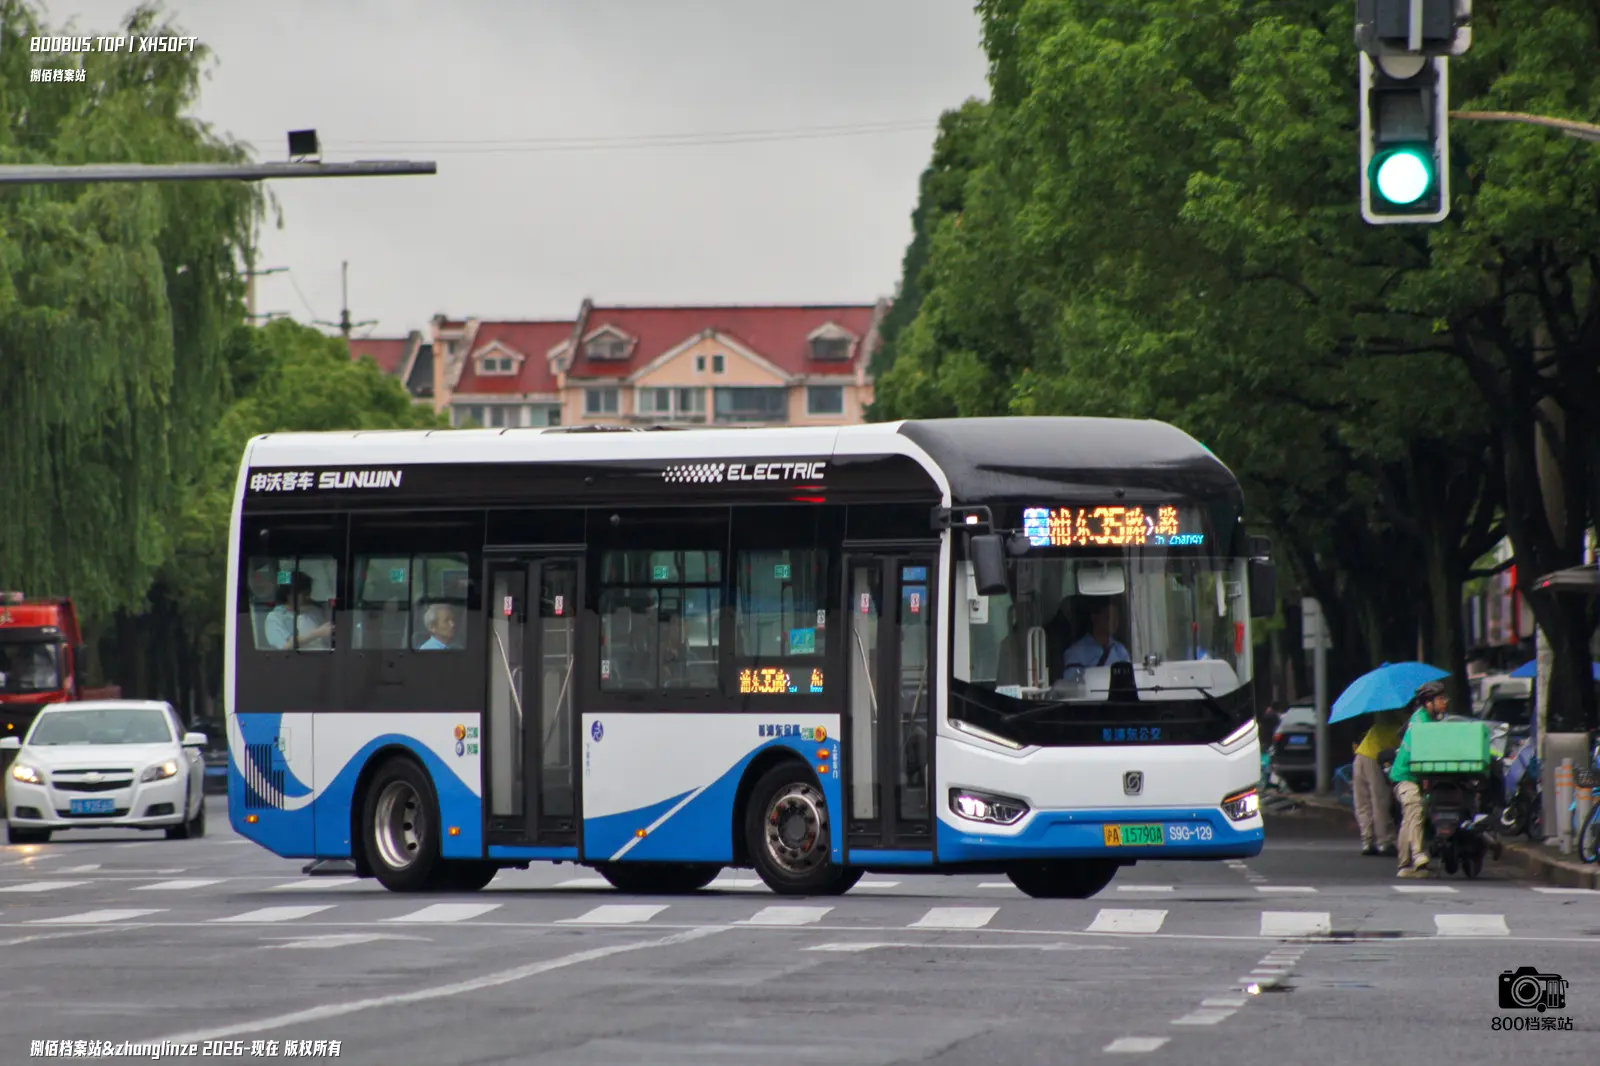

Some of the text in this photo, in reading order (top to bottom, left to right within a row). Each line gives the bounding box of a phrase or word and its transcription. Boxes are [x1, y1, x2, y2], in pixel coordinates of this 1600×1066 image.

[250, 470, 402, 491] 申沃客车 SUNWIN
[727, 462, 826, 481] ELECTRIC
[1169, 826, 1212, 840] S9G-129
